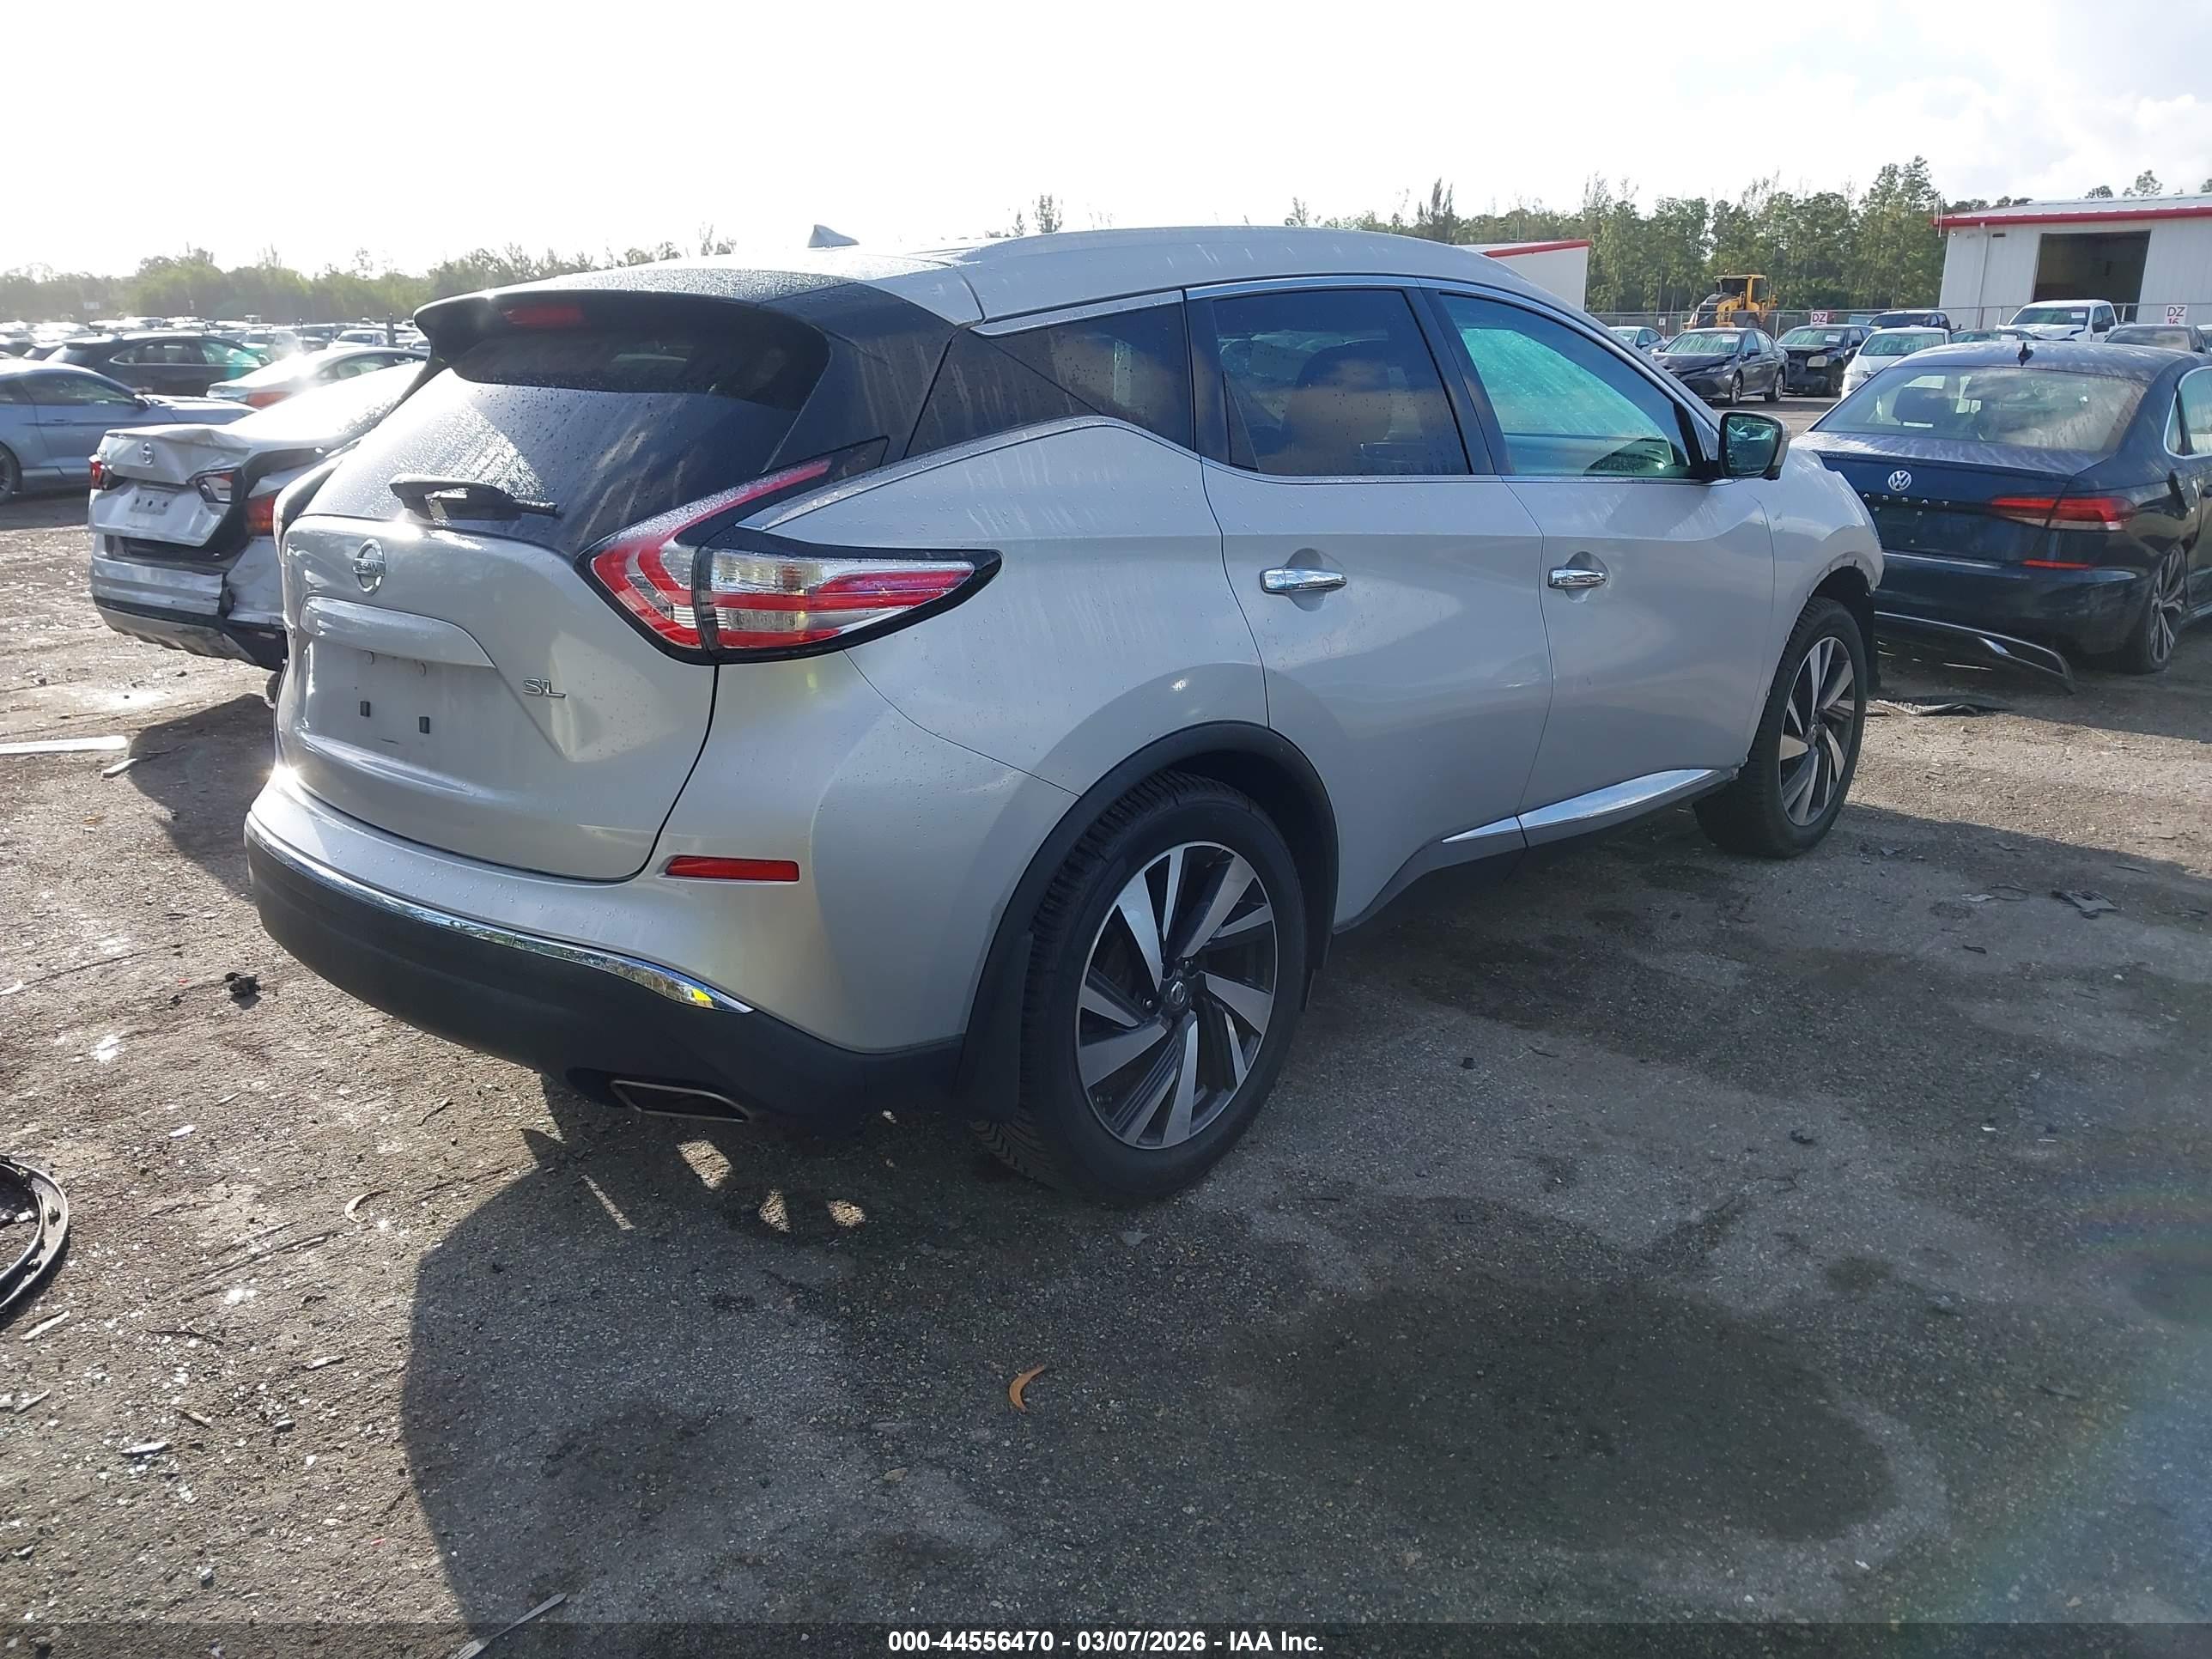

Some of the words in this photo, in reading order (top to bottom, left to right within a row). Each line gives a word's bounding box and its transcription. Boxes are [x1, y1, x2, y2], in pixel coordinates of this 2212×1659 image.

[2167, 307, 2185, 317] DZ
[1812, 313, 1826, 323] DZ
[1863, 493, 1949, 506] ASSAT
[522, 678, 567, 698] SL
